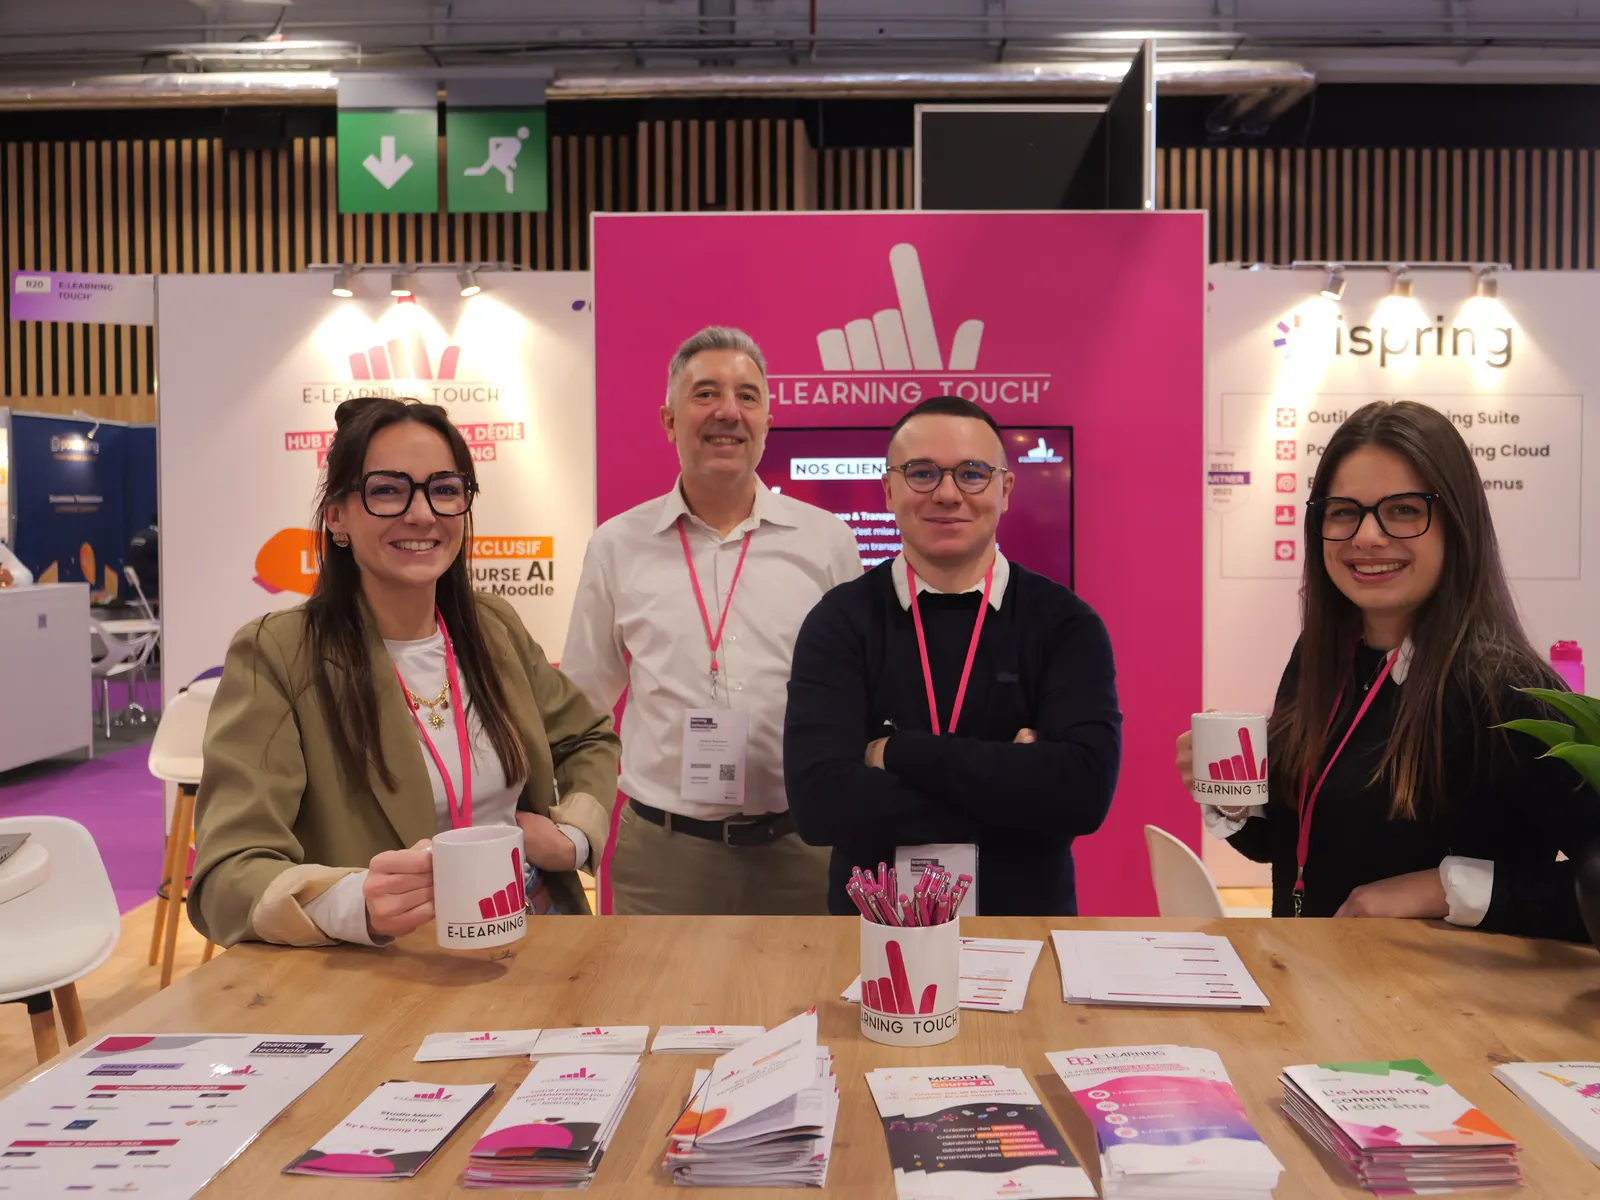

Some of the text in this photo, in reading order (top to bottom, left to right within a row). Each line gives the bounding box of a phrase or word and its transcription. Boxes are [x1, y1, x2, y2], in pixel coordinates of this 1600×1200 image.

[25, 280, 44, 289] R20
[1335, 314, 1513, 369] ispring
[768, 380, 923, 405] -LEARNING
[1478, 411, 1520, 424] Suite
[287, 433, 322, 450] HUB
[1500, 444, 1550, 457] Cloud
[795, 463, 830, 475] NOS
[472, 540, 542, 555] XCLUSIF
[475, 560, 554, 581] URSE AI
[492, 583, 554, 596] Moodle
[447, 916, 524, 939] E-LEARNING
[260, 1041, 307, 1049] learning
[1331, 1096, 1398, 1104] comme
